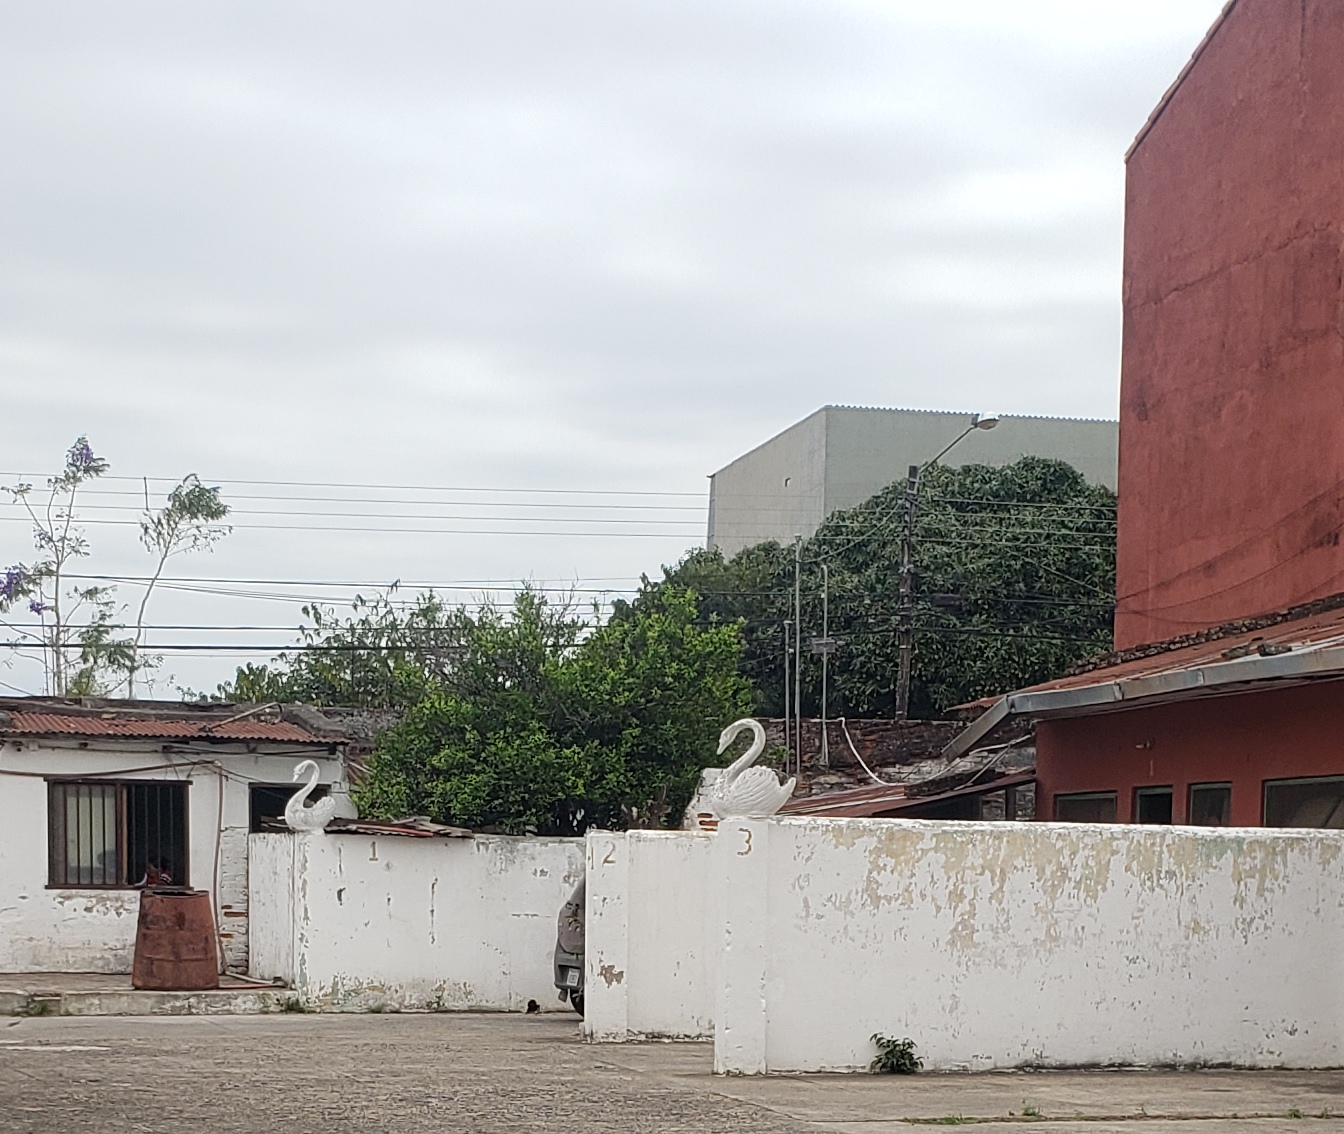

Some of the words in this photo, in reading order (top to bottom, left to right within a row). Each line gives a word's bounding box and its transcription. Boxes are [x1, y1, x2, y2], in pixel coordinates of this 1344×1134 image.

[369, 841, 379, 861] 1
[602, 841, 616, 867] 2
[737, 827, 752, 856] 3
